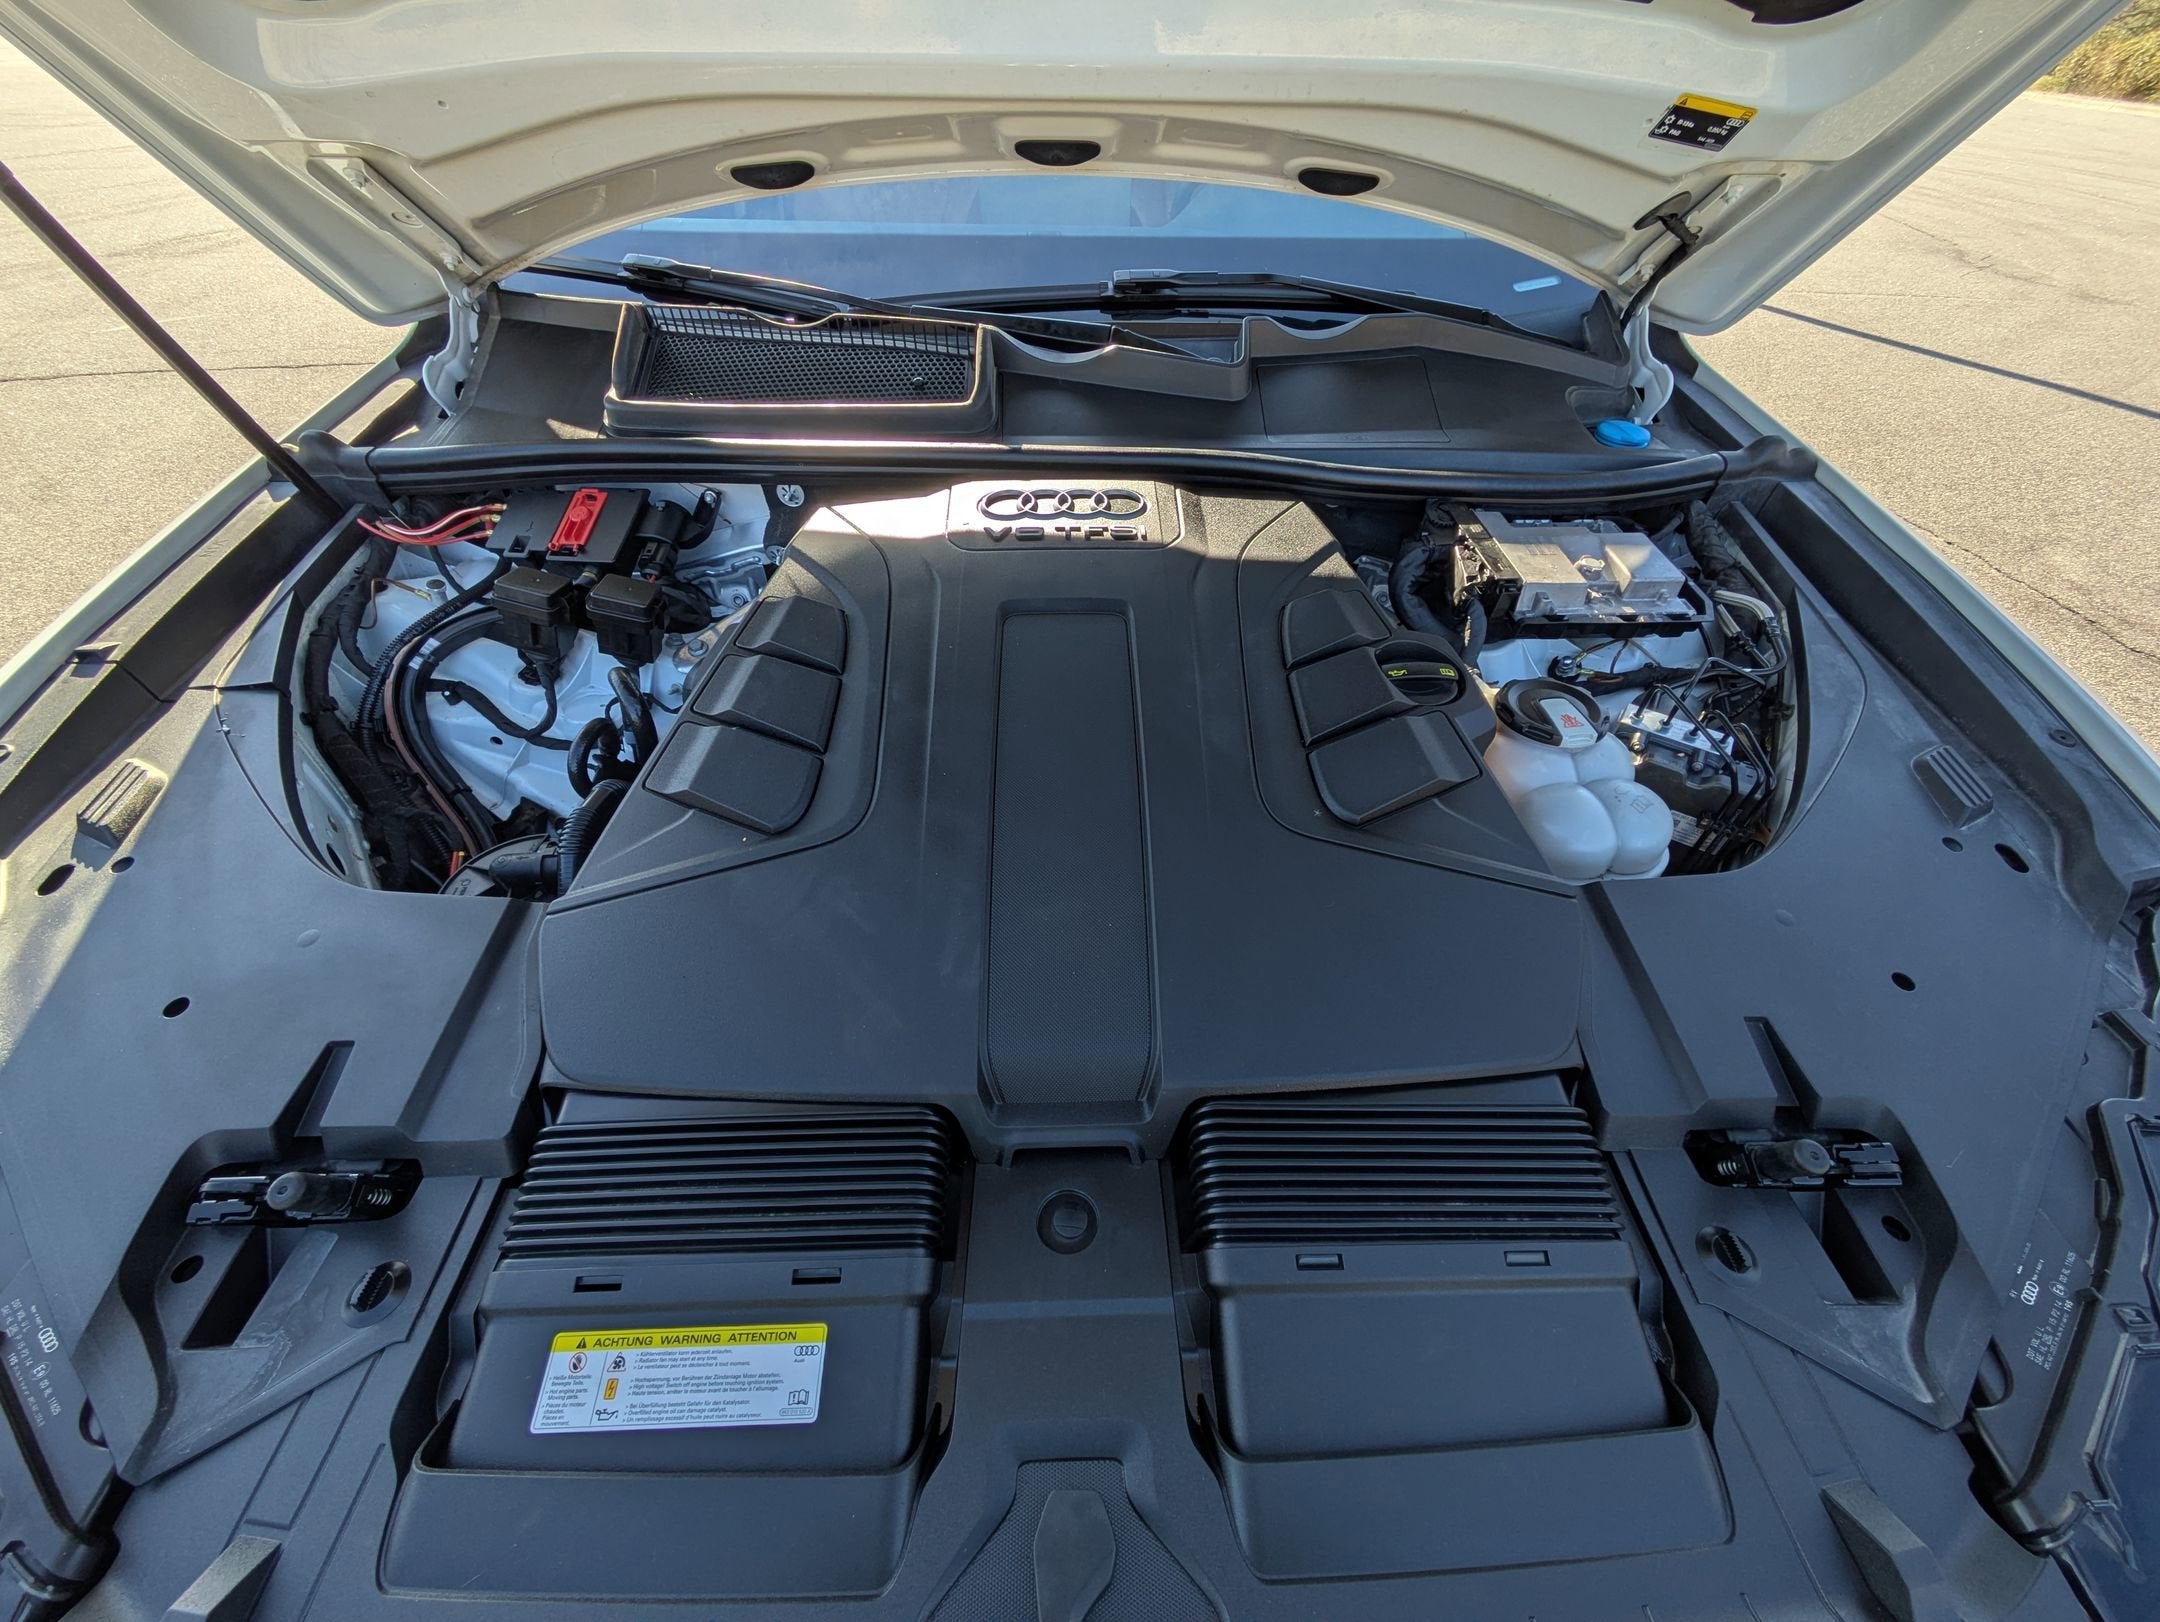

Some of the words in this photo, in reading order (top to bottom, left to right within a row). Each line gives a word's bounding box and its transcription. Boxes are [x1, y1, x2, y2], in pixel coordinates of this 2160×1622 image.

[984, 526, 1044, 542] V8
[1055, 526, 1147, 542] TFSI
[593, 1335, 654, 1348] ACHTUNG
[660, 1333, 721, 1345] WARNING
[728, 1331, 798, 1343] ATTENTION
